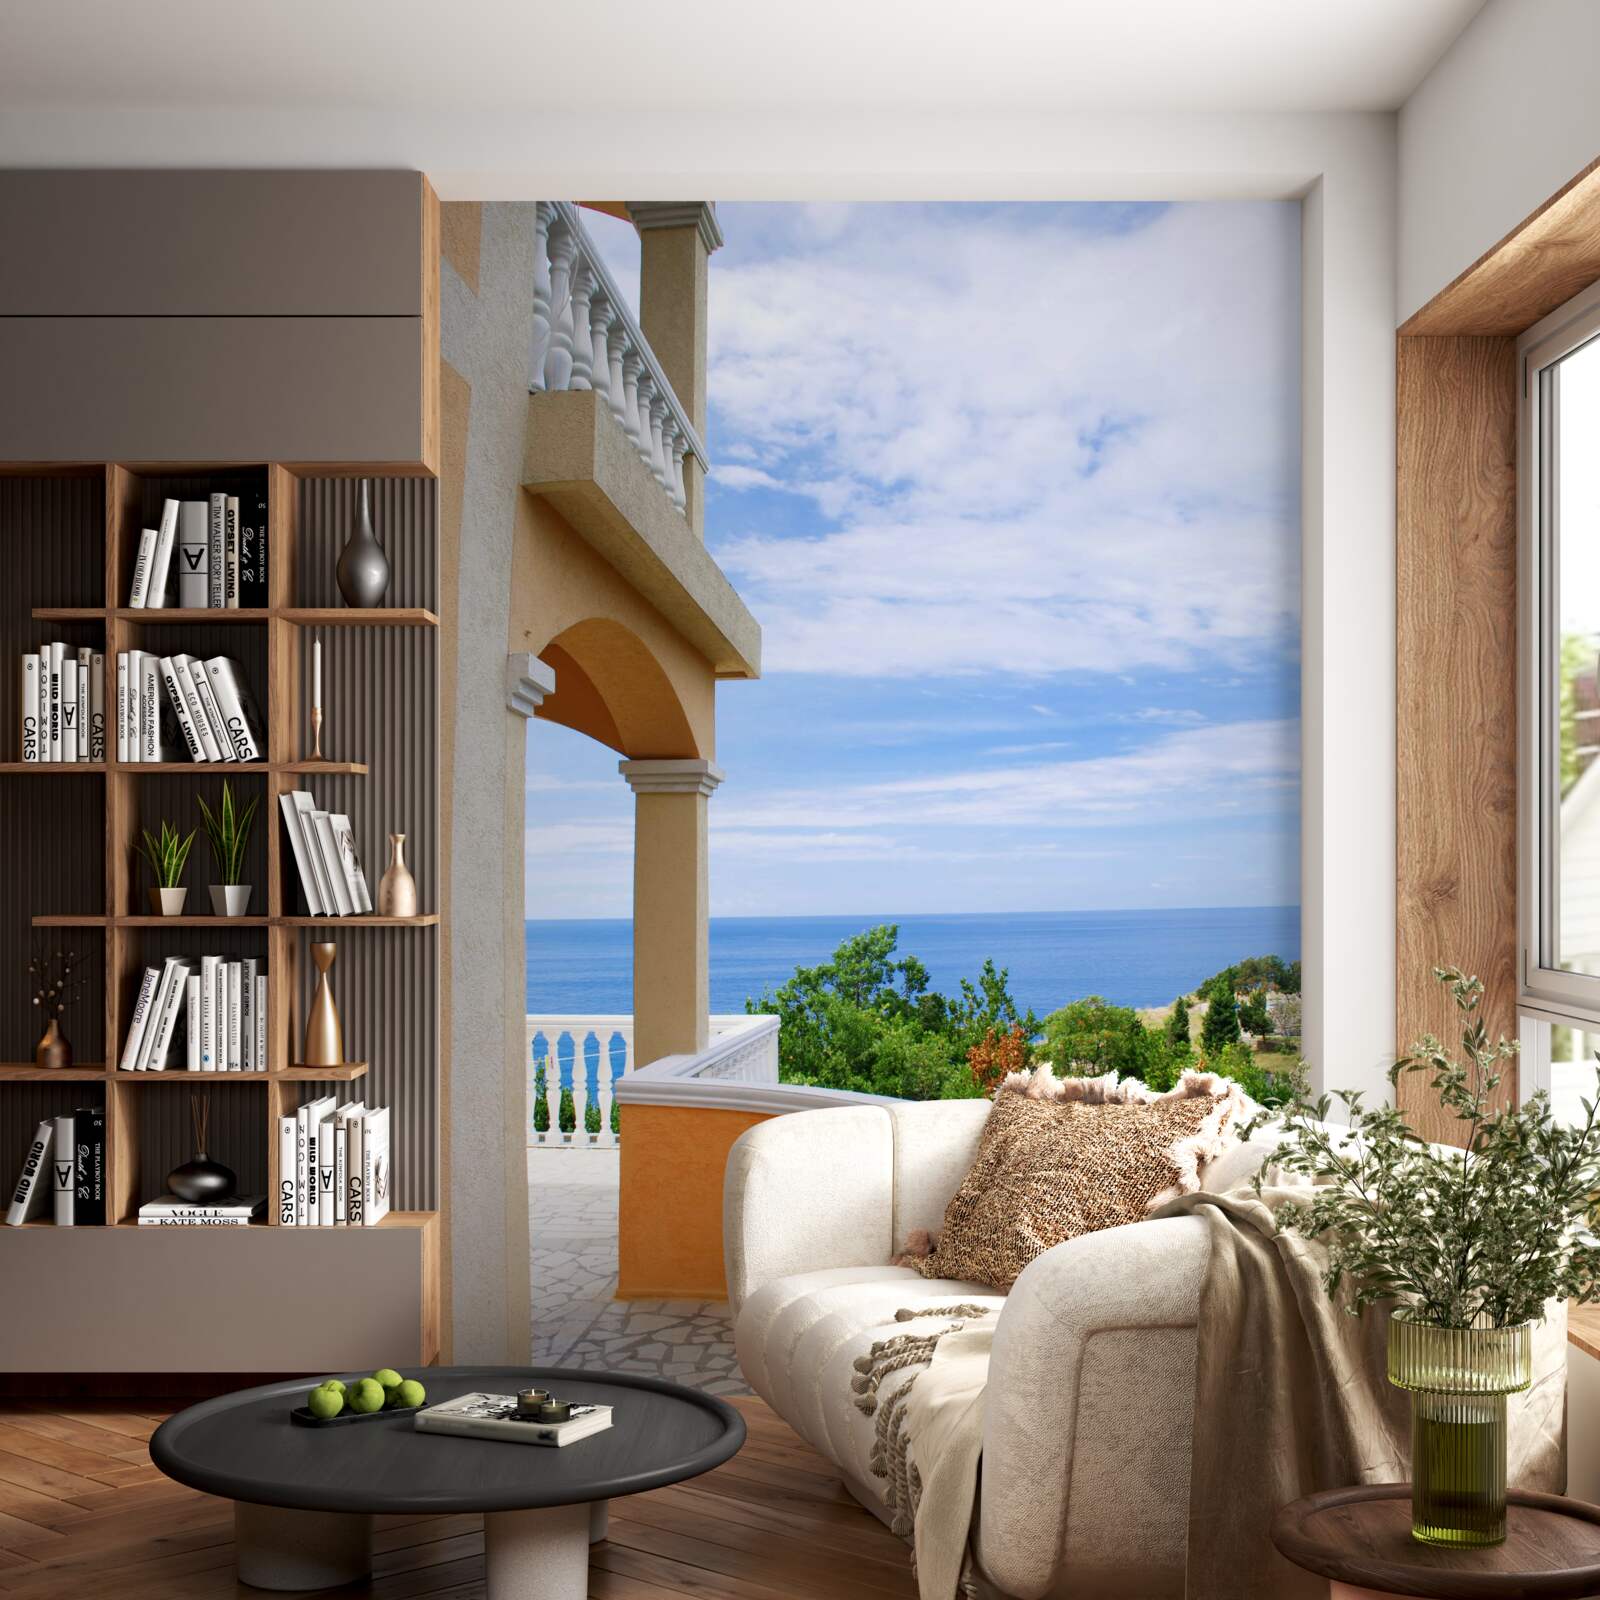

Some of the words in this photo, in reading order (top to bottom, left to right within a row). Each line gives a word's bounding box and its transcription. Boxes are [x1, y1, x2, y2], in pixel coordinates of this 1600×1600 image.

[212, 505, 221, 519] TIM
[212, 521, 221, 553] WALKER
[227, 509, 235, 554] GYPSET
[183, 548, 205, 570] A
[212, 556, 221, 580] STORY
[227, 561, 235, 599] LIVING
[212, 583, 221, 608] TELLER
[187, 692, 197, 706] ECO
[64, 706, 75, 726] A
[166, 675, 185, 714] GYPSET
[182, 721, 199, 755] LIVING
[24, 717, 36, 760] CARS
[93, 713, 104, 758] CARS
[227, 717, 253, 760] CARS
[14, 1178, 31, 1204] WILD
[24, 1141, 45, 1178] WORLD
[56, 1165, 71, 1188] A
[321, 1170, 332, 1189] A
[171, 1209, 224, 1217] VOGUE
[281, 1180, 293, 1223] CARS
[350, 1177, 361, 1222] CARS
[160, 1218, 197, 1226] KATE
[200, 1218, 239, 1226] MOSS
